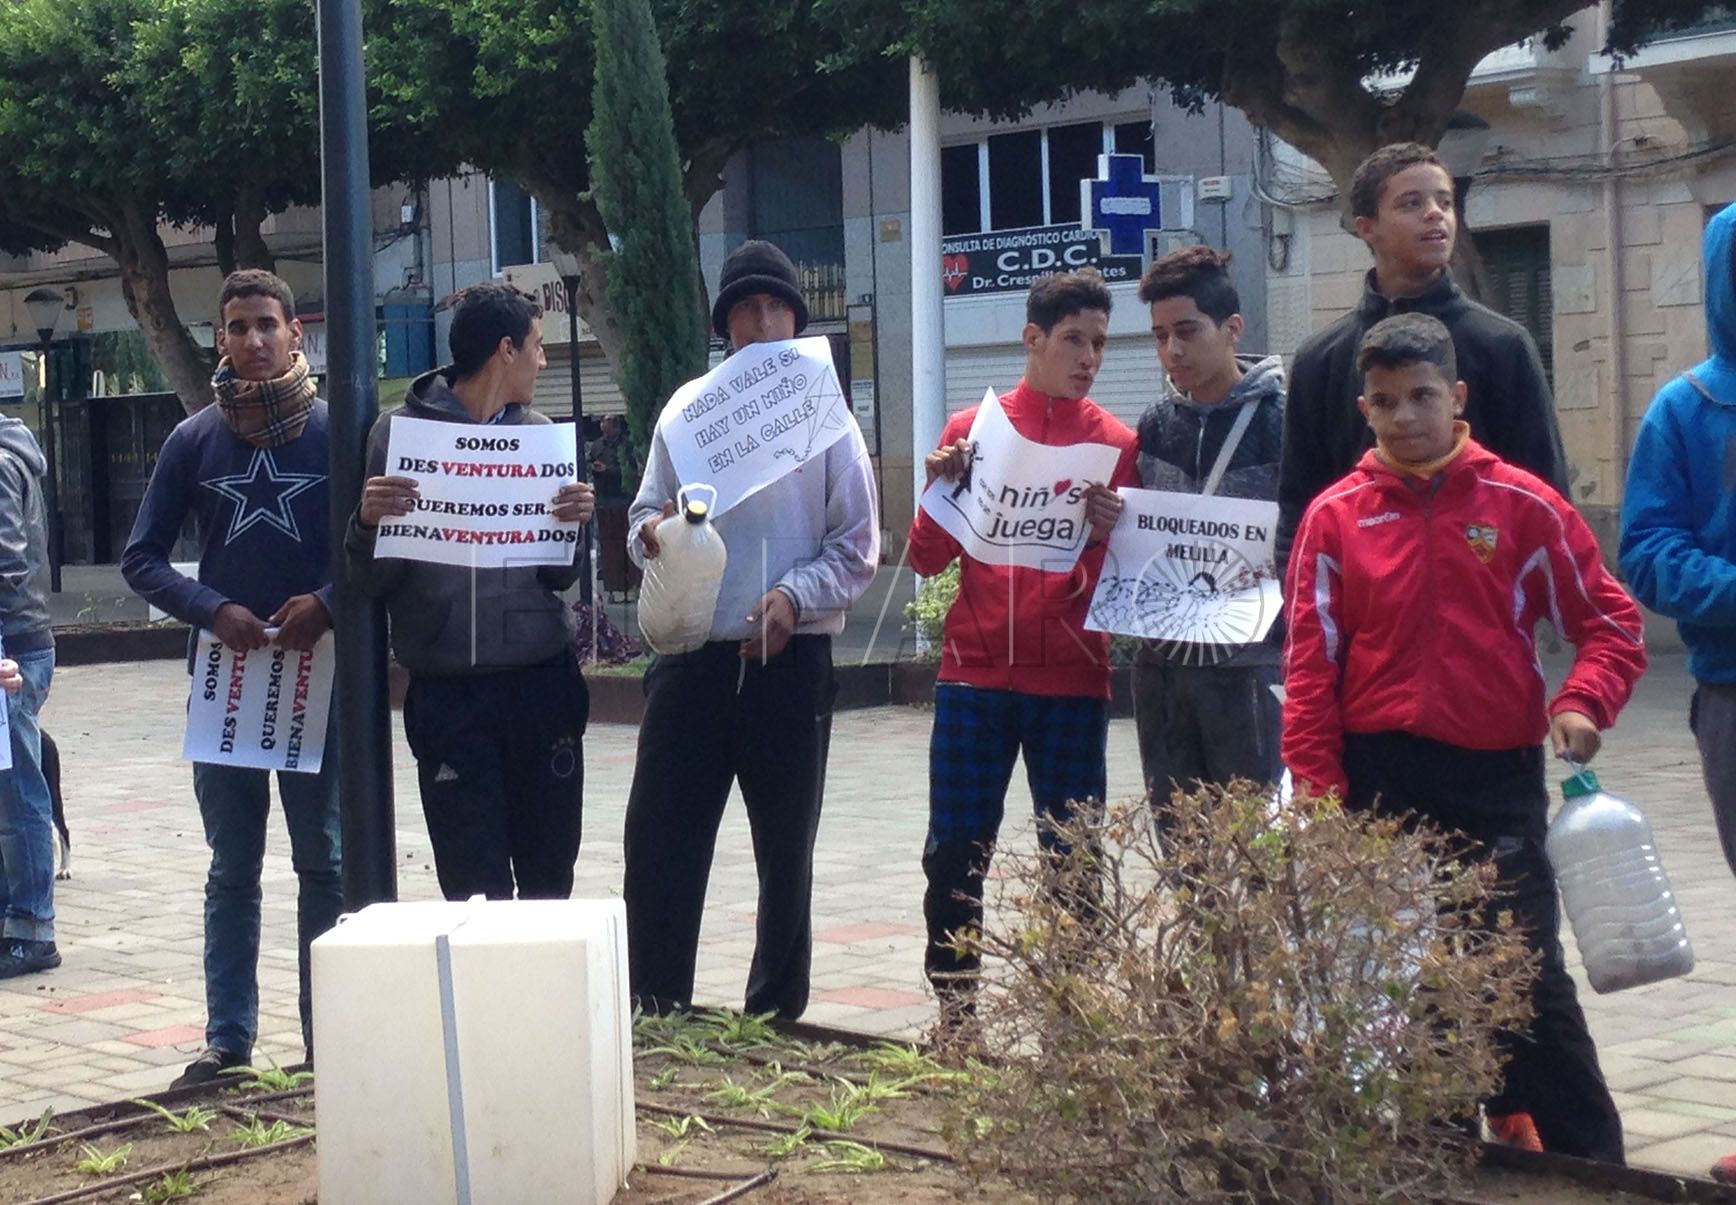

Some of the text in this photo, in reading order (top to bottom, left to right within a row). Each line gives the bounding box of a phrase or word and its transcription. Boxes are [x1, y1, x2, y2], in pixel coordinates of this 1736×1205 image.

[982, 237, 995, 250] DE
[996, 231, 1060, 249] DIAGNÓSTICO
[997, 245, 1098, 272] C.D.C.
[972, 276, 995, 289] Dr.
[682, 386, 731, 423] NADA
[730, 357, 777, 393] VALE
[695, 373, 808, 448] HAY UN NIÑO
[455, 437, 520, 451] SOMOS
[707, 399, 816, 473] EN LA CALLE
[987, 512, 1074, 540] juega
[1138, 514, 1267, 542] BLOQUEADOS EN
[1166, 543, 1229, 565] MELILLA
[204, 642, 223, 701] SOMOS
[261, 650, 285, 750] QUEREMOS
